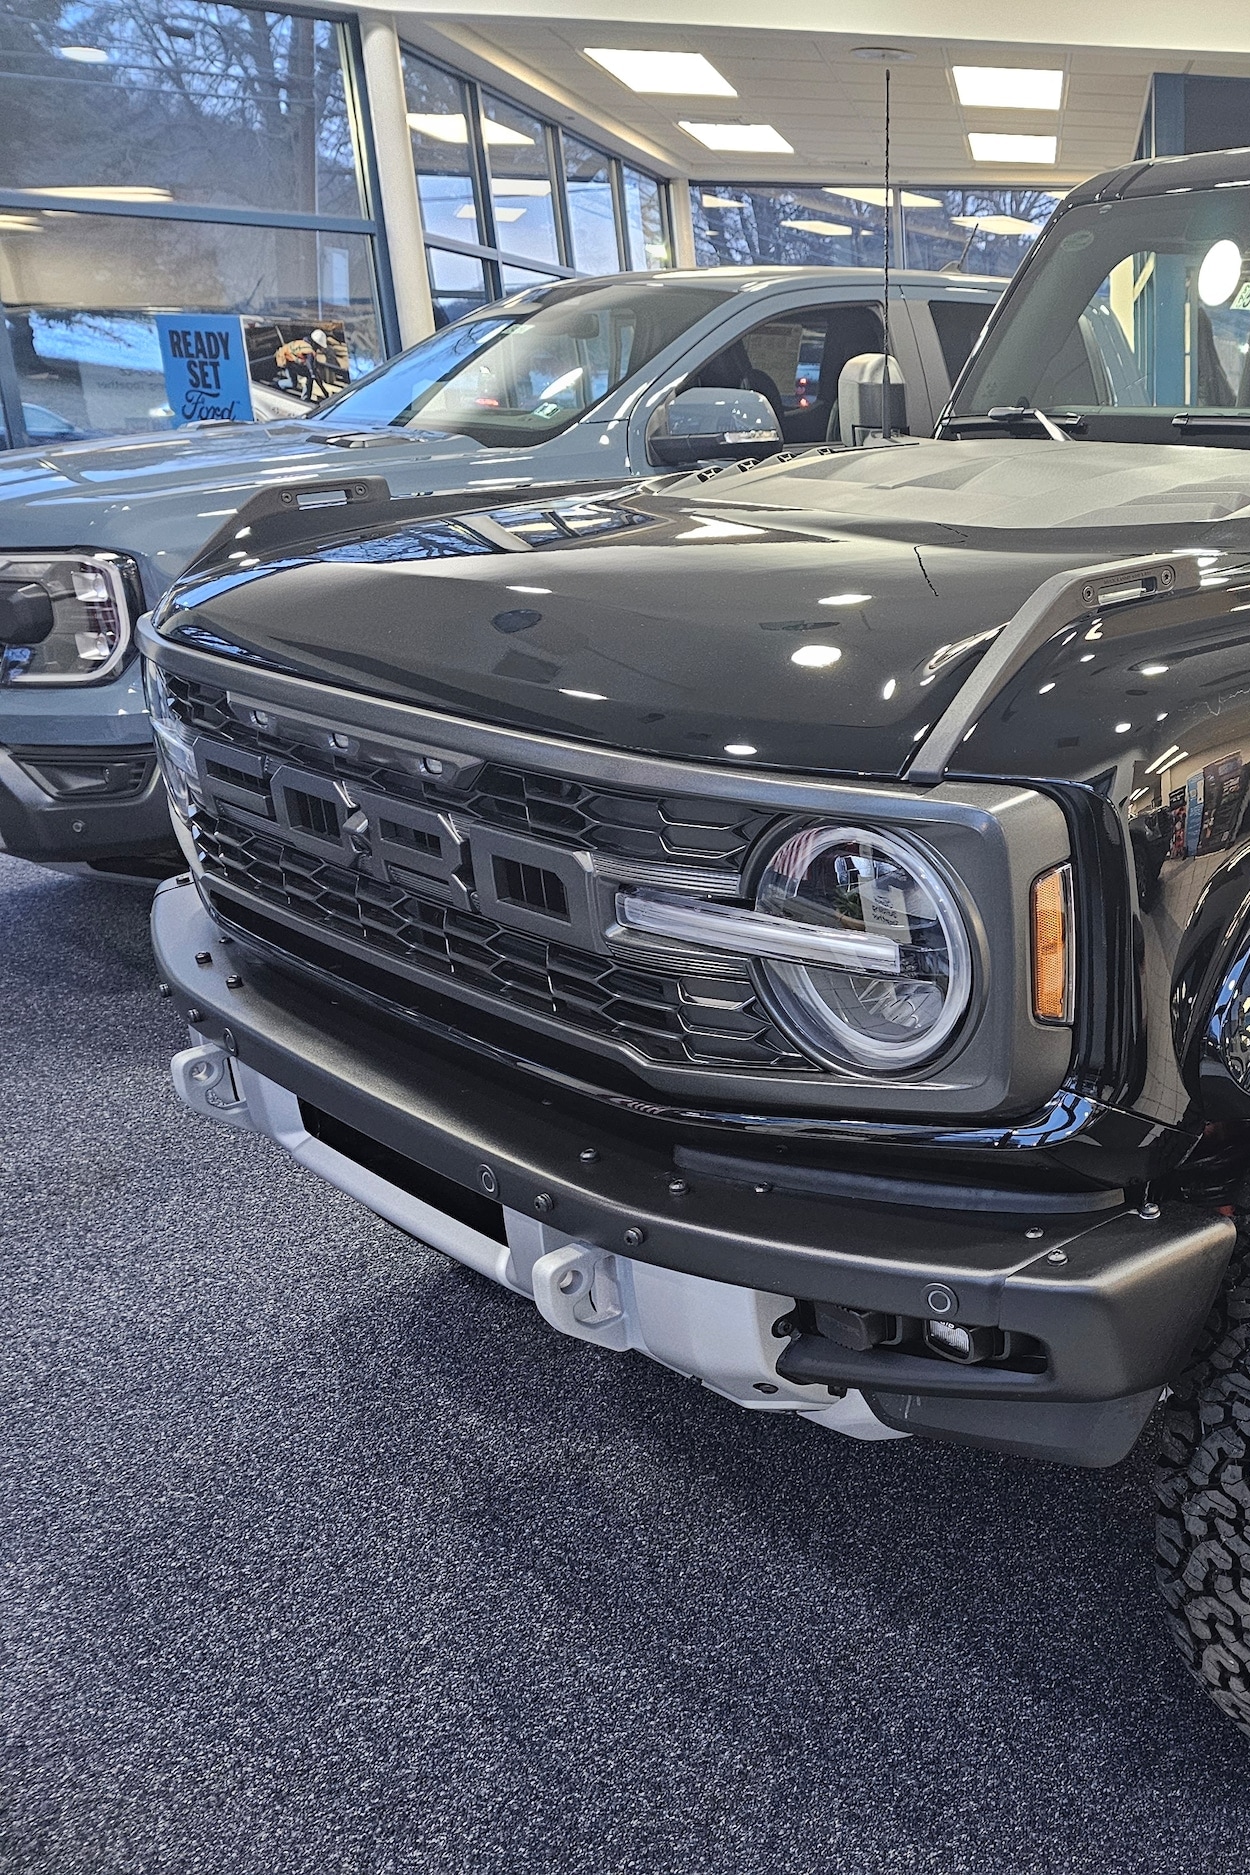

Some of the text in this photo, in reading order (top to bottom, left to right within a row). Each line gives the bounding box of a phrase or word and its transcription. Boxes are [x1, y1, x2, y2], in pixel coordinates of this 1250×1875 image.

[168, 329, 230, 360] READY
[186, 360, 221, 390] SET
[182, 389, 237, 421] Ford
[193, 736, 612, 956] FORD
